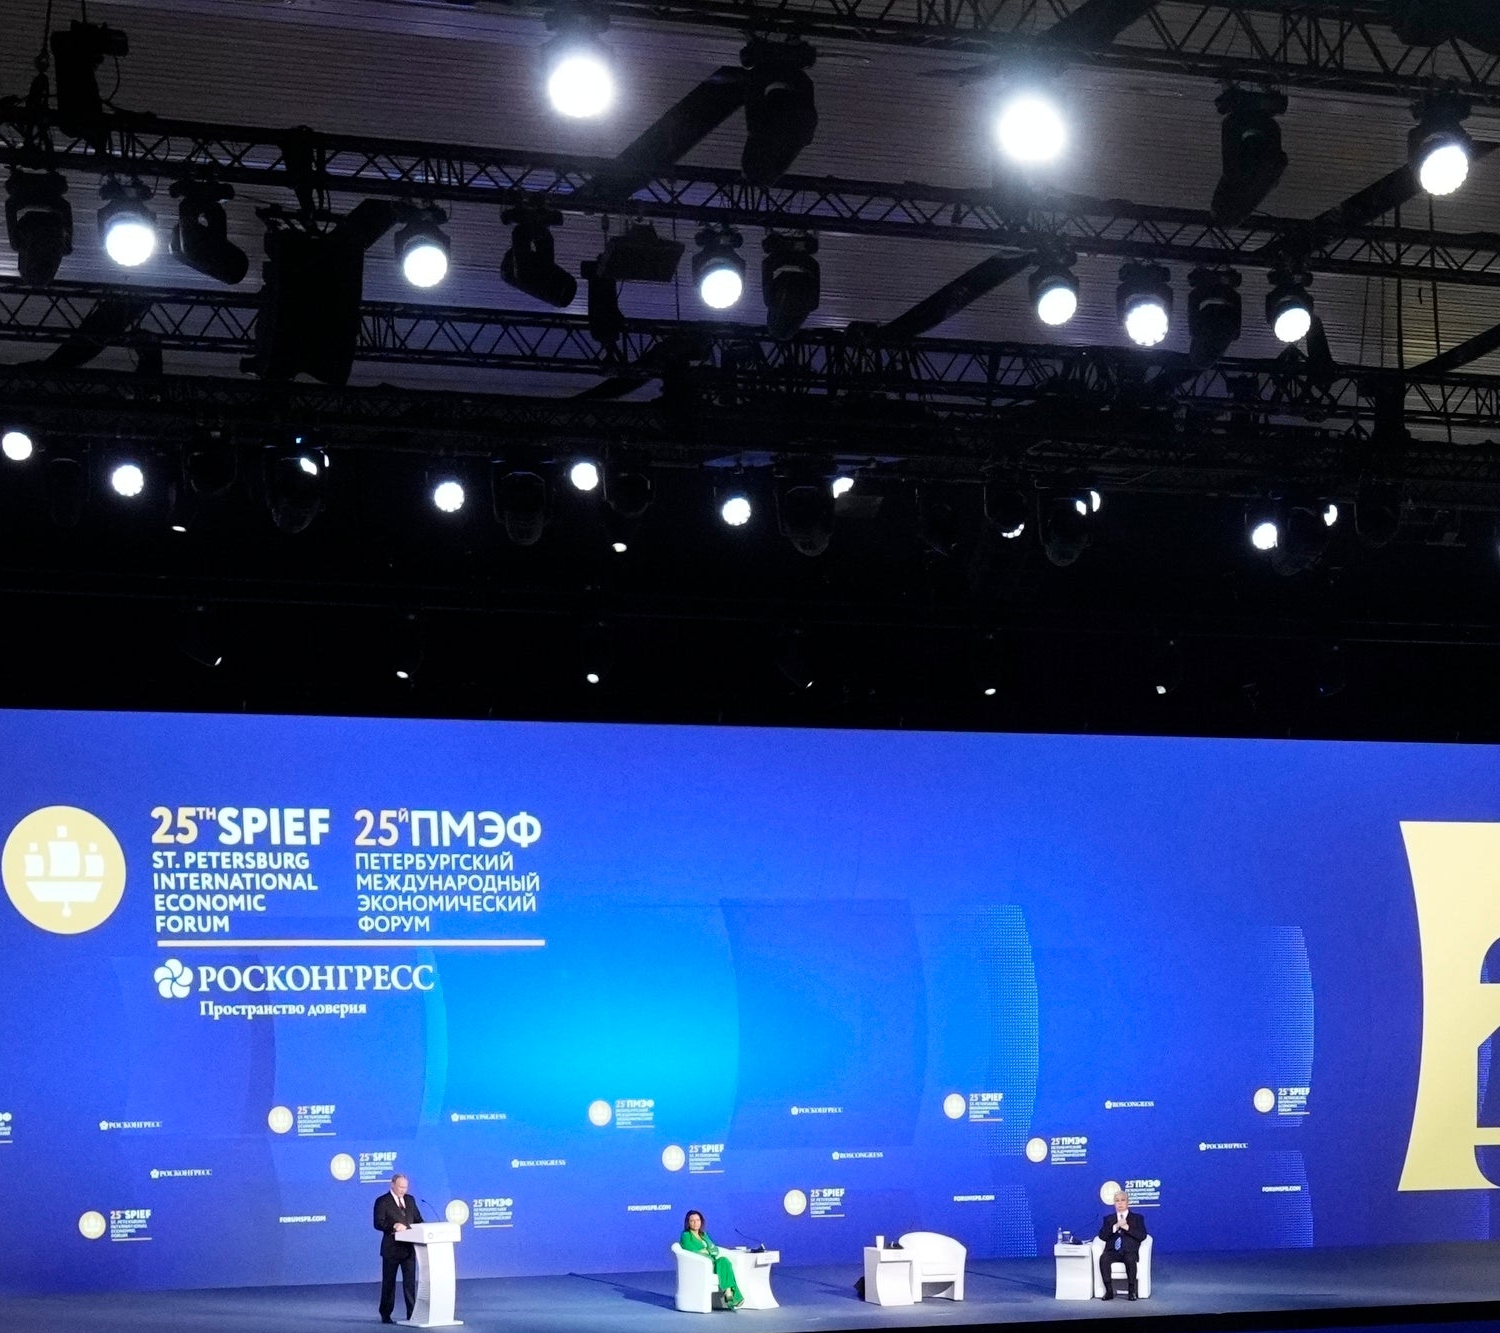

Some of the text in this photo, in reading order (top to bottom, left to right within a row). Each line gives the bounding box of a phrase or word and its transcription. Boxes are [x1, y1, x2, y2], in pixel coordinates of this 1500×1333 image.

[218, 807, 330, 846] SPIEF
[410, 810, 542, 848] ПМЭФ
[152, 852, 310, 870] ST. PETERSBURG
[355, 851, 514, 871] ПЕТЕРБУРГСКИЙ
[153, 873, 318, 891] INTERNATIONAL
[356, 872, 540, 894] МЕЖДУНАРОДНЫЙ
[154, 894, 267, 912] ECONOMIC
[358, 893, 537, 913] ЭКОНОМИЧЕСКИЙ
[156, 915, 229, 933] FORUM
[358, 915, 430, 933] ФОРУМ
[198, 964, 435, 992] РОСКОНГРЕСС
[200, 1000, 367, 1020] Пространство доверия
